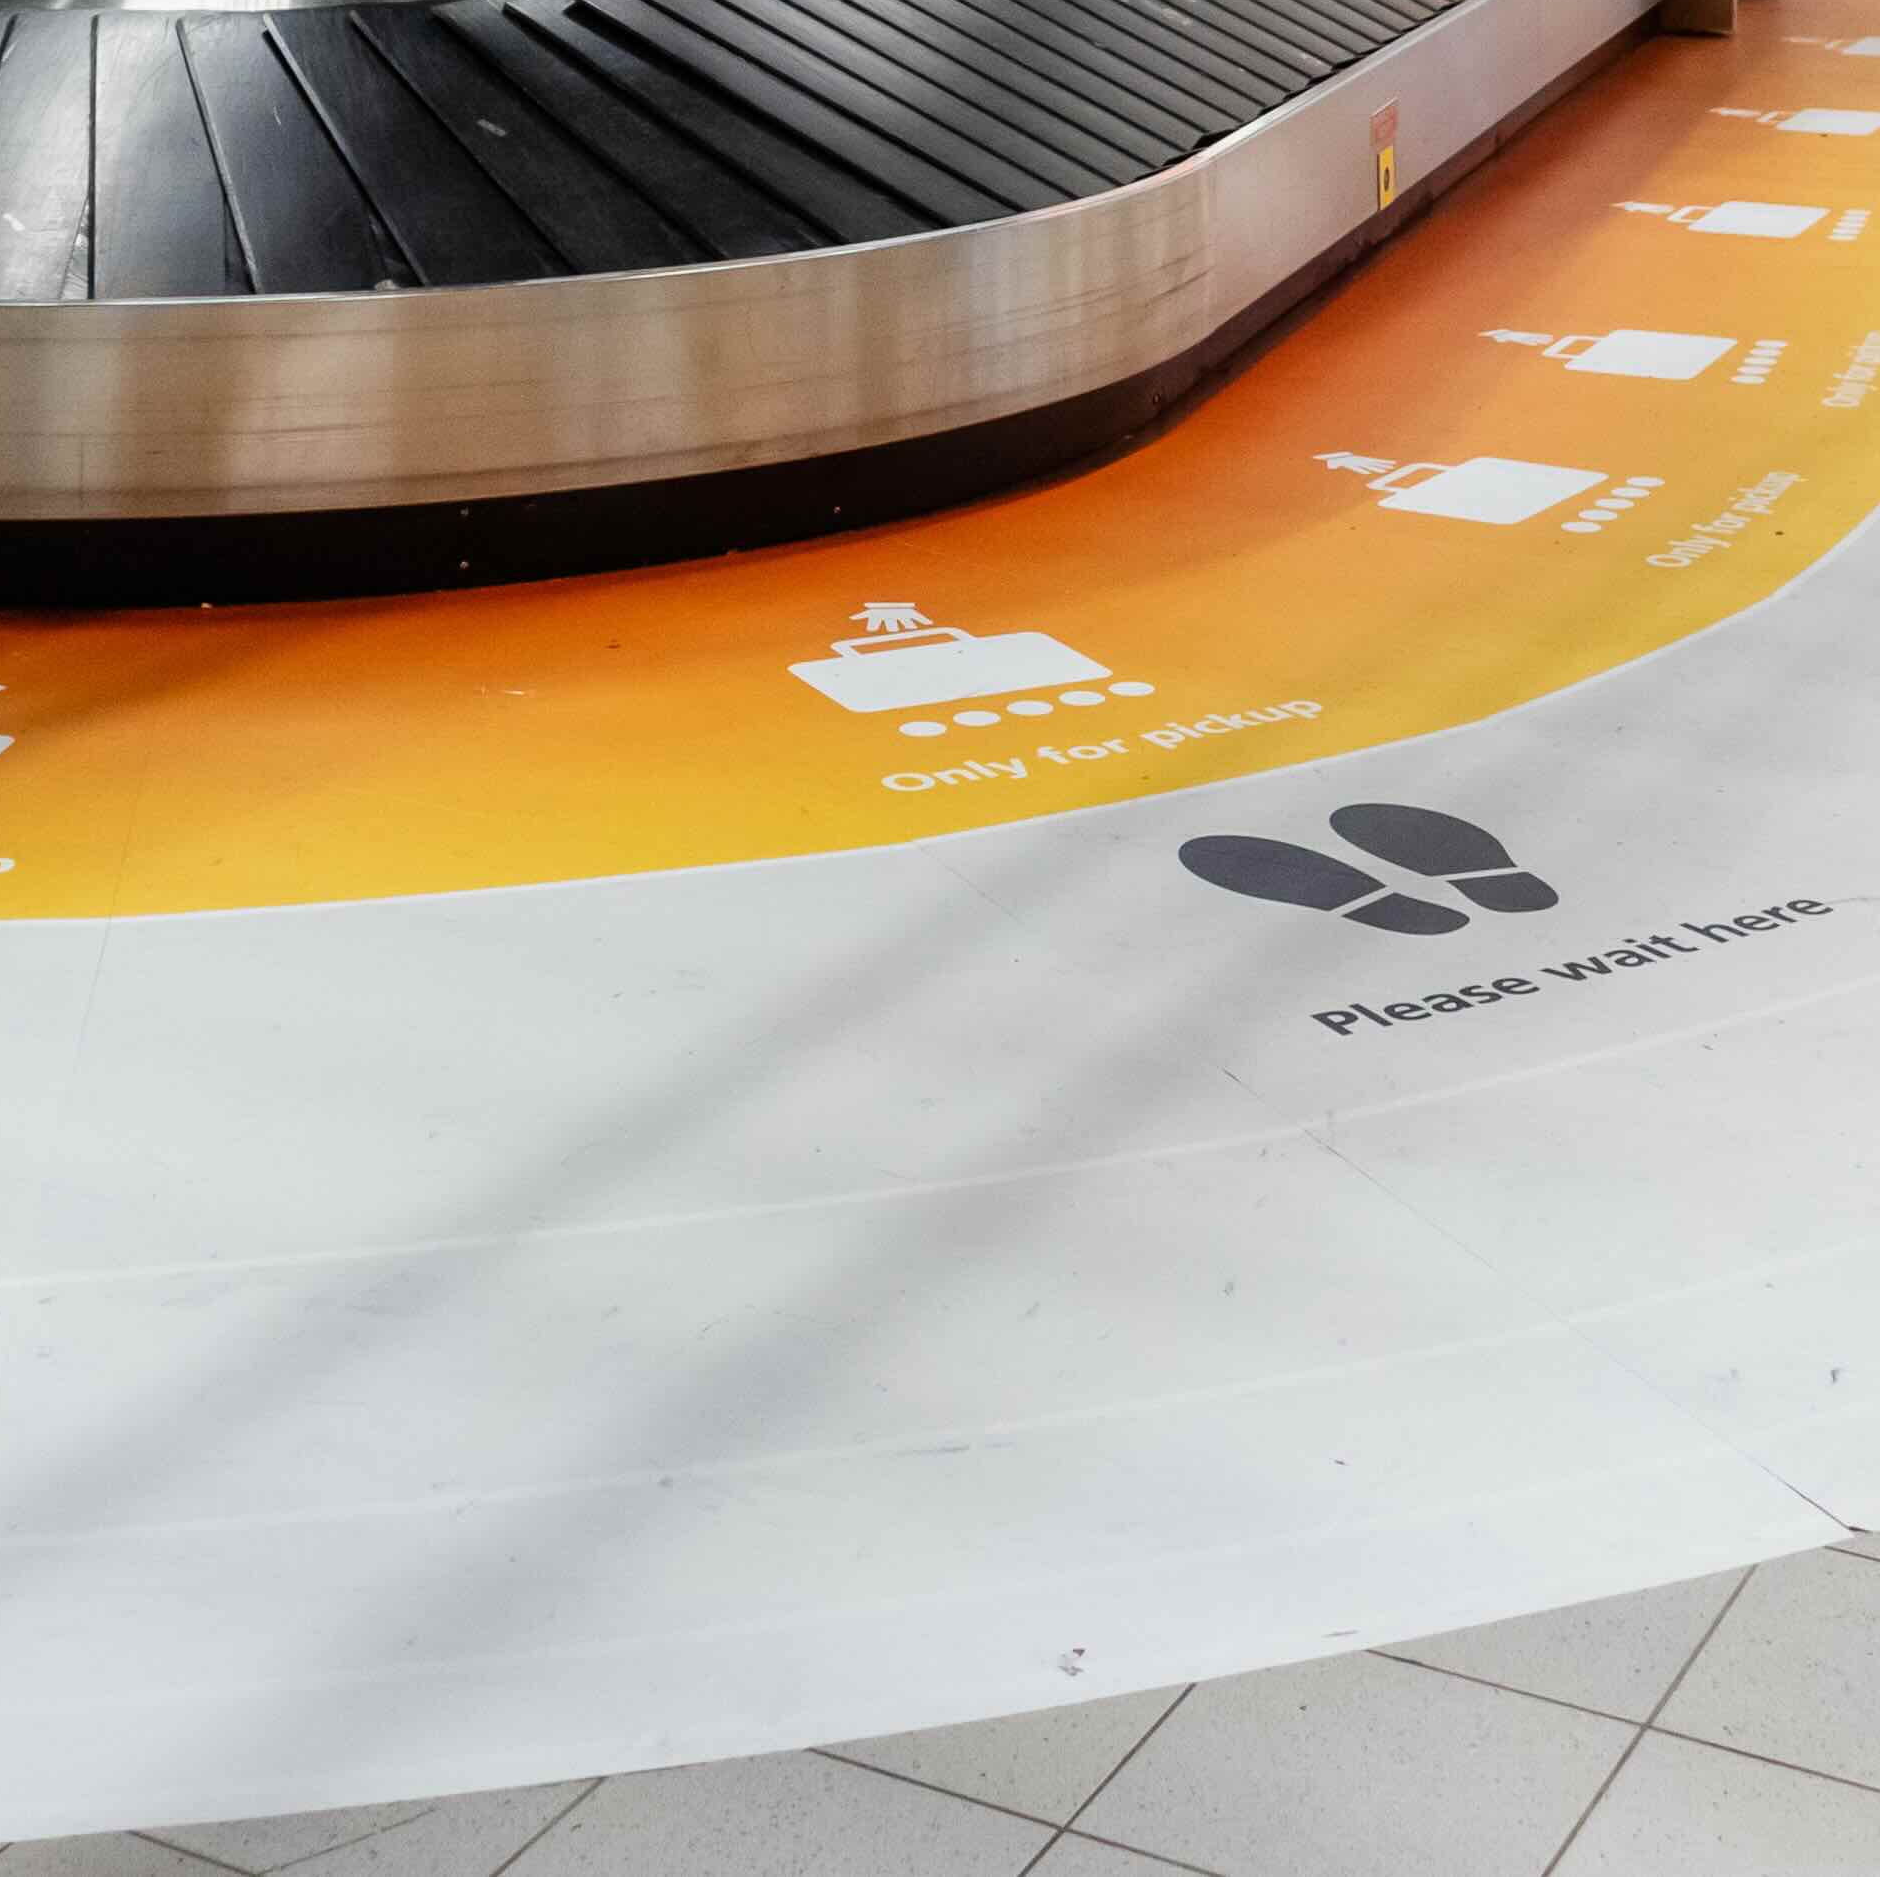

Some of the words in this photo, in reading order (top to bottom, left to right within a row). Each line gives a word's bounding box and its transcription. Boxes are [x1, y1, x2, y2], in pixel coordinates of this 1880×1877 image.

[880, 755, 1029, 793] Only
[1036, 736, 1130, 765] for
[1139, 699, 1324, 751] pickup
[1311, 976, 1541, 1036] Please
[1541, 933, 1701, 982] wait
[1679, 897, 1834, 944] here
